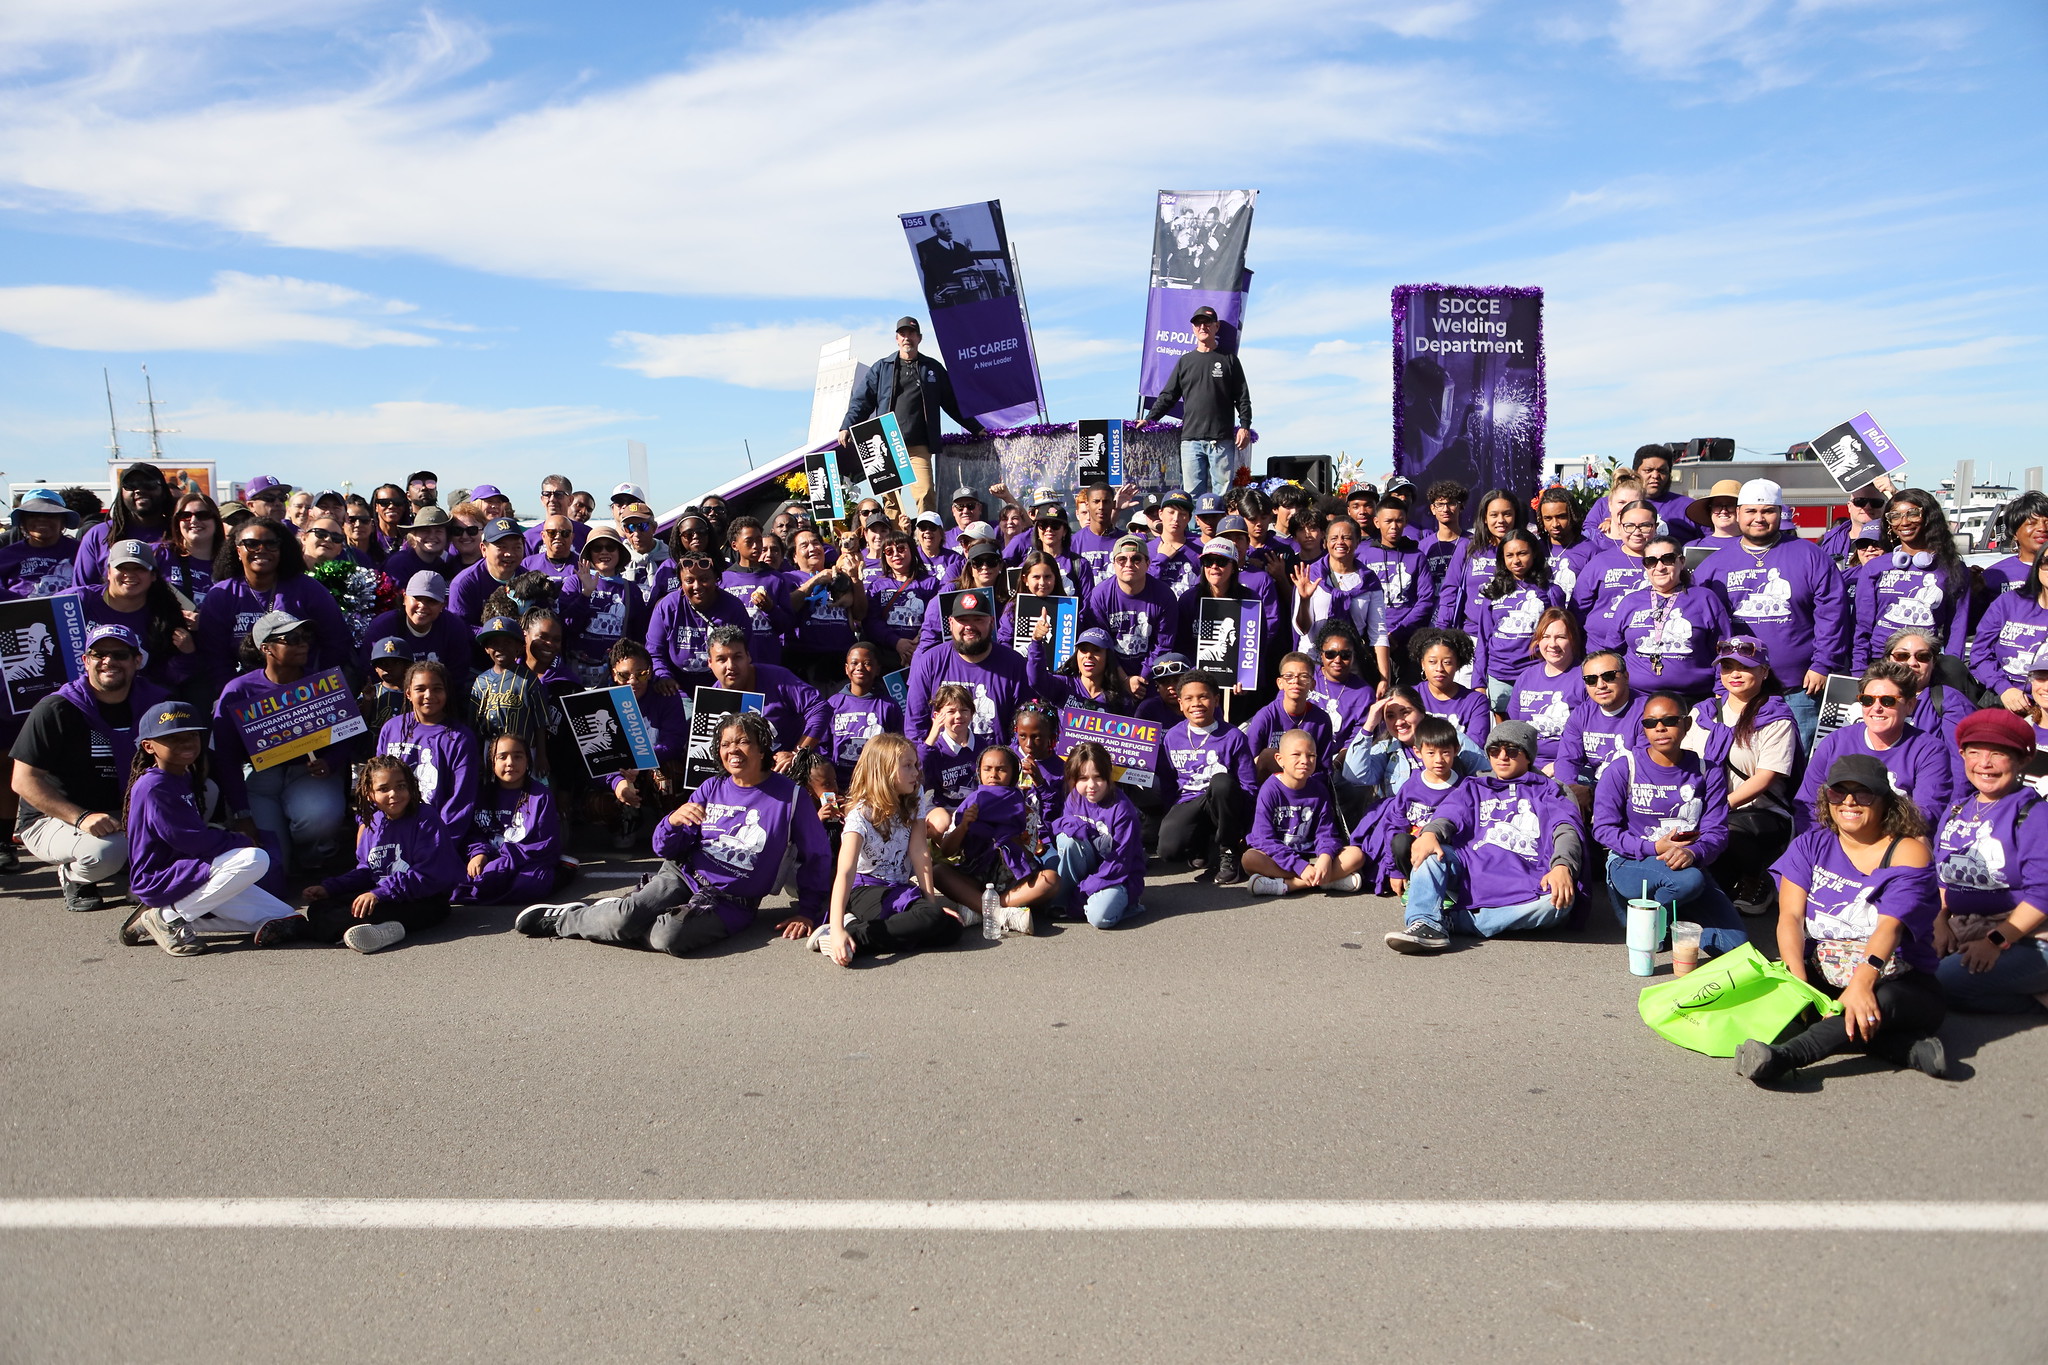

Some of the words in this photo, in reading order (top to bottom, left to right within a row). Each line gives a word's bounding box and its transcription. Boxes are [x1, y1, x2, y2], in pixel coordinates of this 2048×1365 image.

[904, 217, 923, 228] 1956
[1439, 298, 1501, 314] SDCCE
[1432, 317, 1507, 337] Welding
[1156, 330, 1169, 342] HIS
[958, 346, 978, 361] HIS
[979, 337, 1018, 355] CAREER
[1415, 337, 1524, 355] Department
[980, 358, 993, 368] New
[993, 355, 1013, 367] Leader
[1862, 427, 1890, 454] Loyal
[889, 430, 909, 469] Inspire
[1110, 429, 1120, 476] Kindness
[829, 463, 842, 508] Progress
[1604, 575, 1620, 583] DAY
[1727, 579, 1744, 587] DAY
[1879, 580, 1897, 588] DAY
[1881, 573, 1900, 582] KING
[1899, 574, 1911, 582] JR.
[2000, 631, 2020, 641] DAY
[2003, 624, 2024, 636] KING
[2023, 628, 2036, 637] JR.
[70, 601, 86, 678] severance
[1241, 620, 1258, 669] Rejoice
[235, 674, 343, 722] WELCOME
[158, 711, 191, 725] Skyline
[245, 712, 292, 734] IMMIGRANTS
[292, 706, 309, 719] AND
[309, 693, 346, 711] REFUGEES
[262, 724, 277, 737] ARE
[276, 713, 316, 731] WELCOME
[316, 704, 336, 718] HERE
[835, 721, 848, 730] DAY
[1067, 712, 1158, 742] WELCOME
[621, 700, 650, 756] Motivate
[1065, 731, 1105, 744] IMMIGRANTS
[1105, 739, 1120, 747] AND
[1120, 741, 1153, 753] REFUGEES
[1584, 742, 1598, 752] DAY
[1122, 749, 1140, 757] HERE
[942, 771, 959, 781] KING
[942, 779, 958, 787] DAY
[1632, 788, 1654, 798] KING
[1654, 790, 1669, 799] JR.
[1632, 796, 1653, 807] DAY
[706, 808, 724, 818] KING
[369, 859, 382, 870] DAY
[1818, 866, 1840, 881] MARTIN
[1838, 876, 1862, 889] LUTHER
[1827, 880, 1844, 893] JR.
